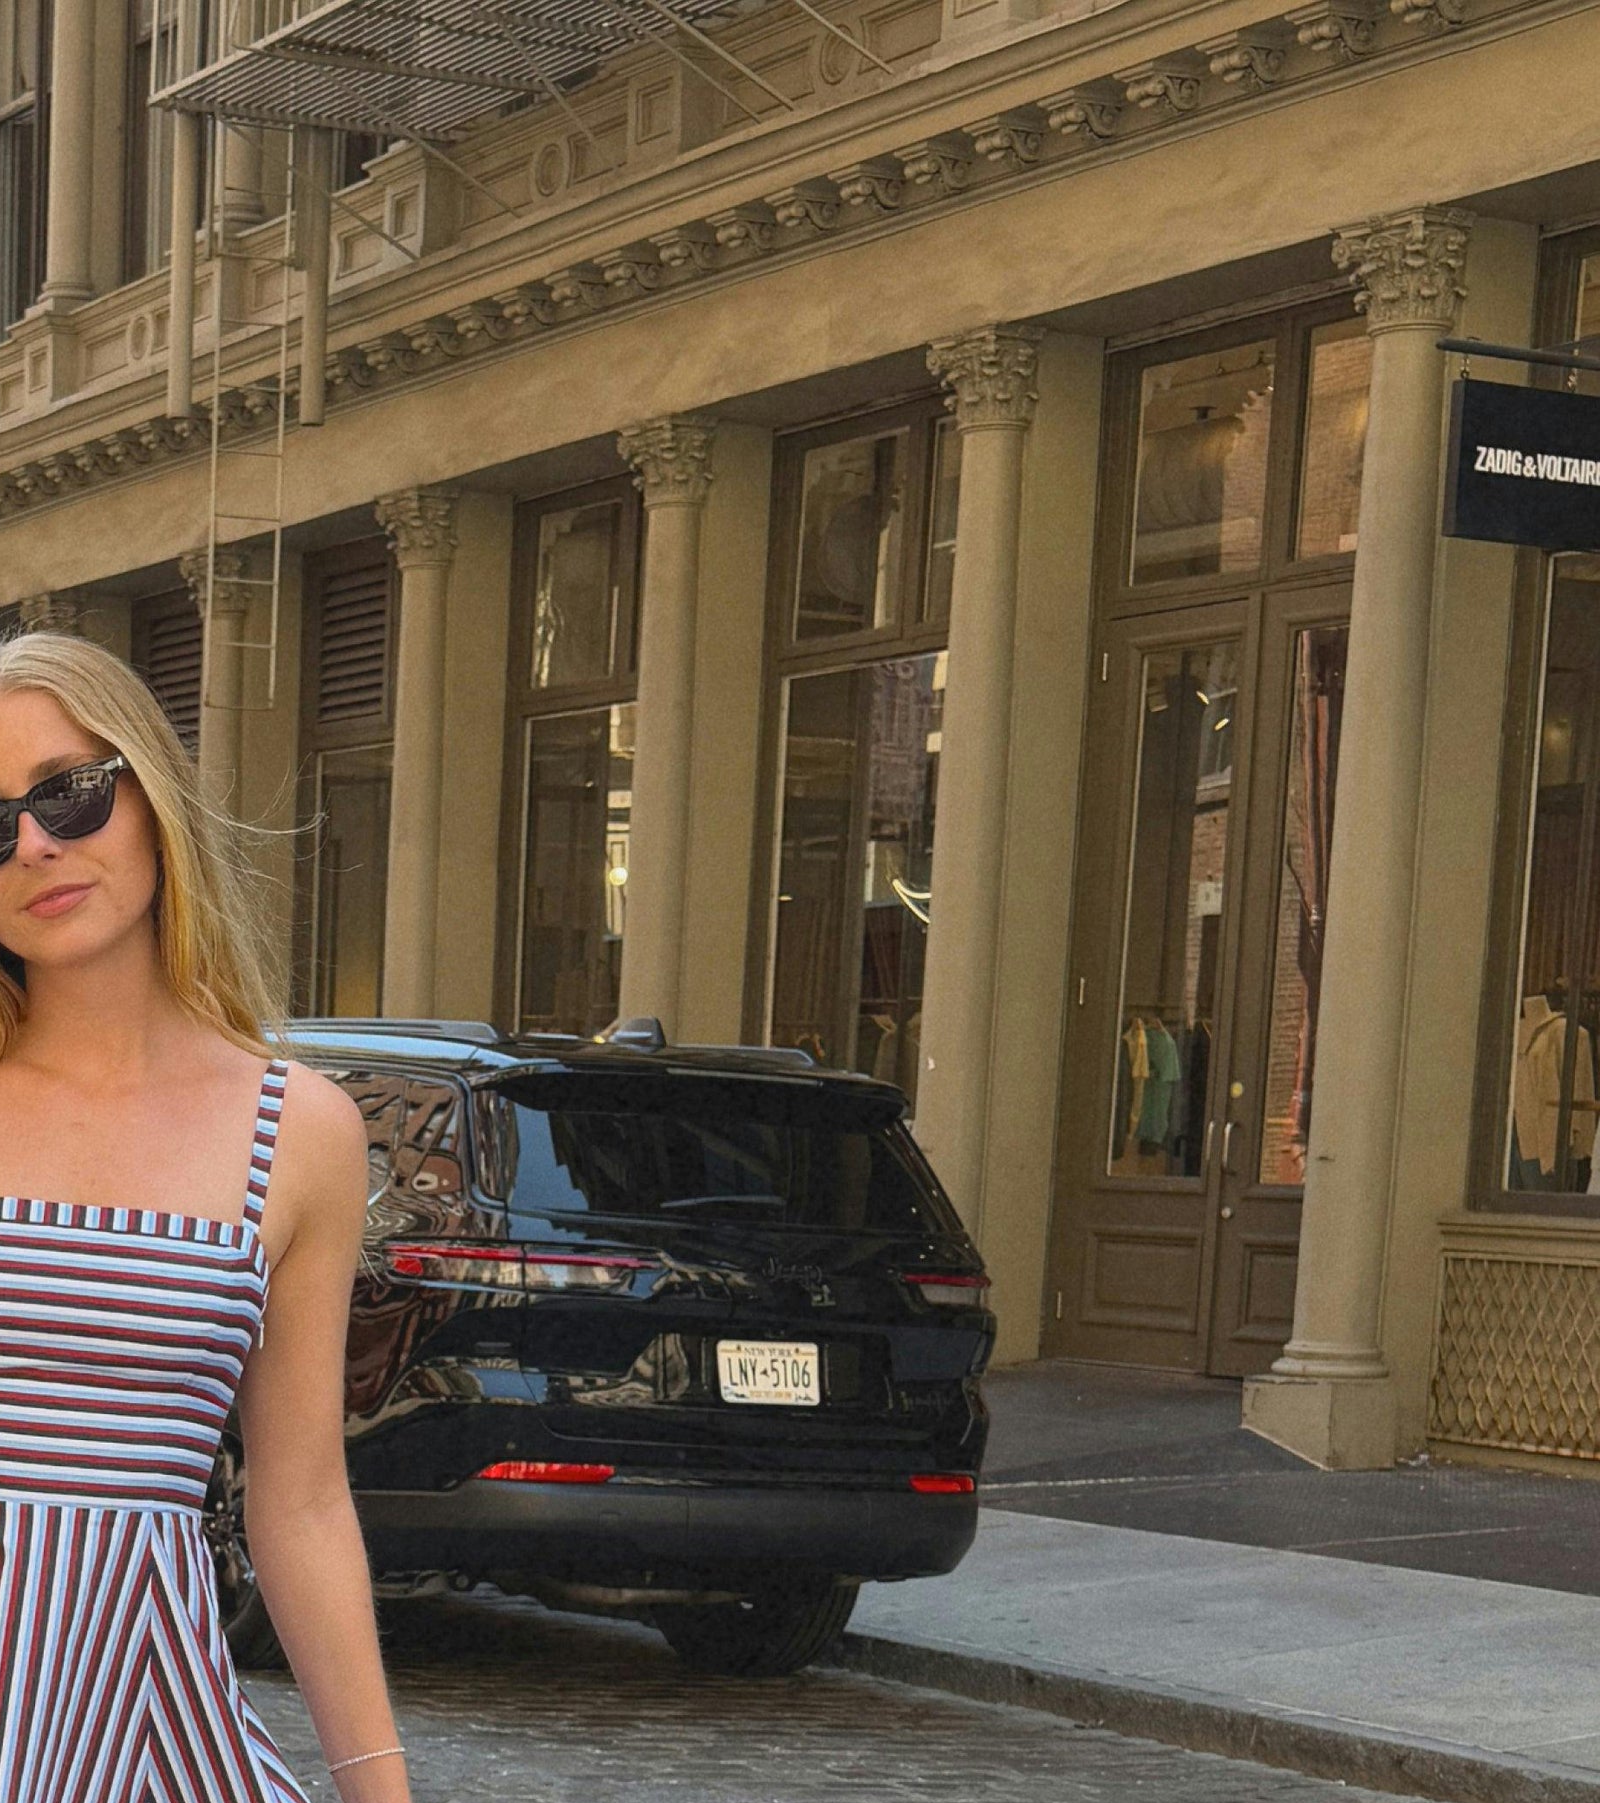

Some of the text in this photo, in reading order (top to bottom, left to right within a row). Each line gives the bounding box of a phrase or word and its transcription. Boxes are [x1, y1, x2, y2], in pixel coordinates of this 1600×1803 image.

[744, 1347, 793, 1357] NEW YORK
[727, 1358, 811, 1389] LNY 5106
